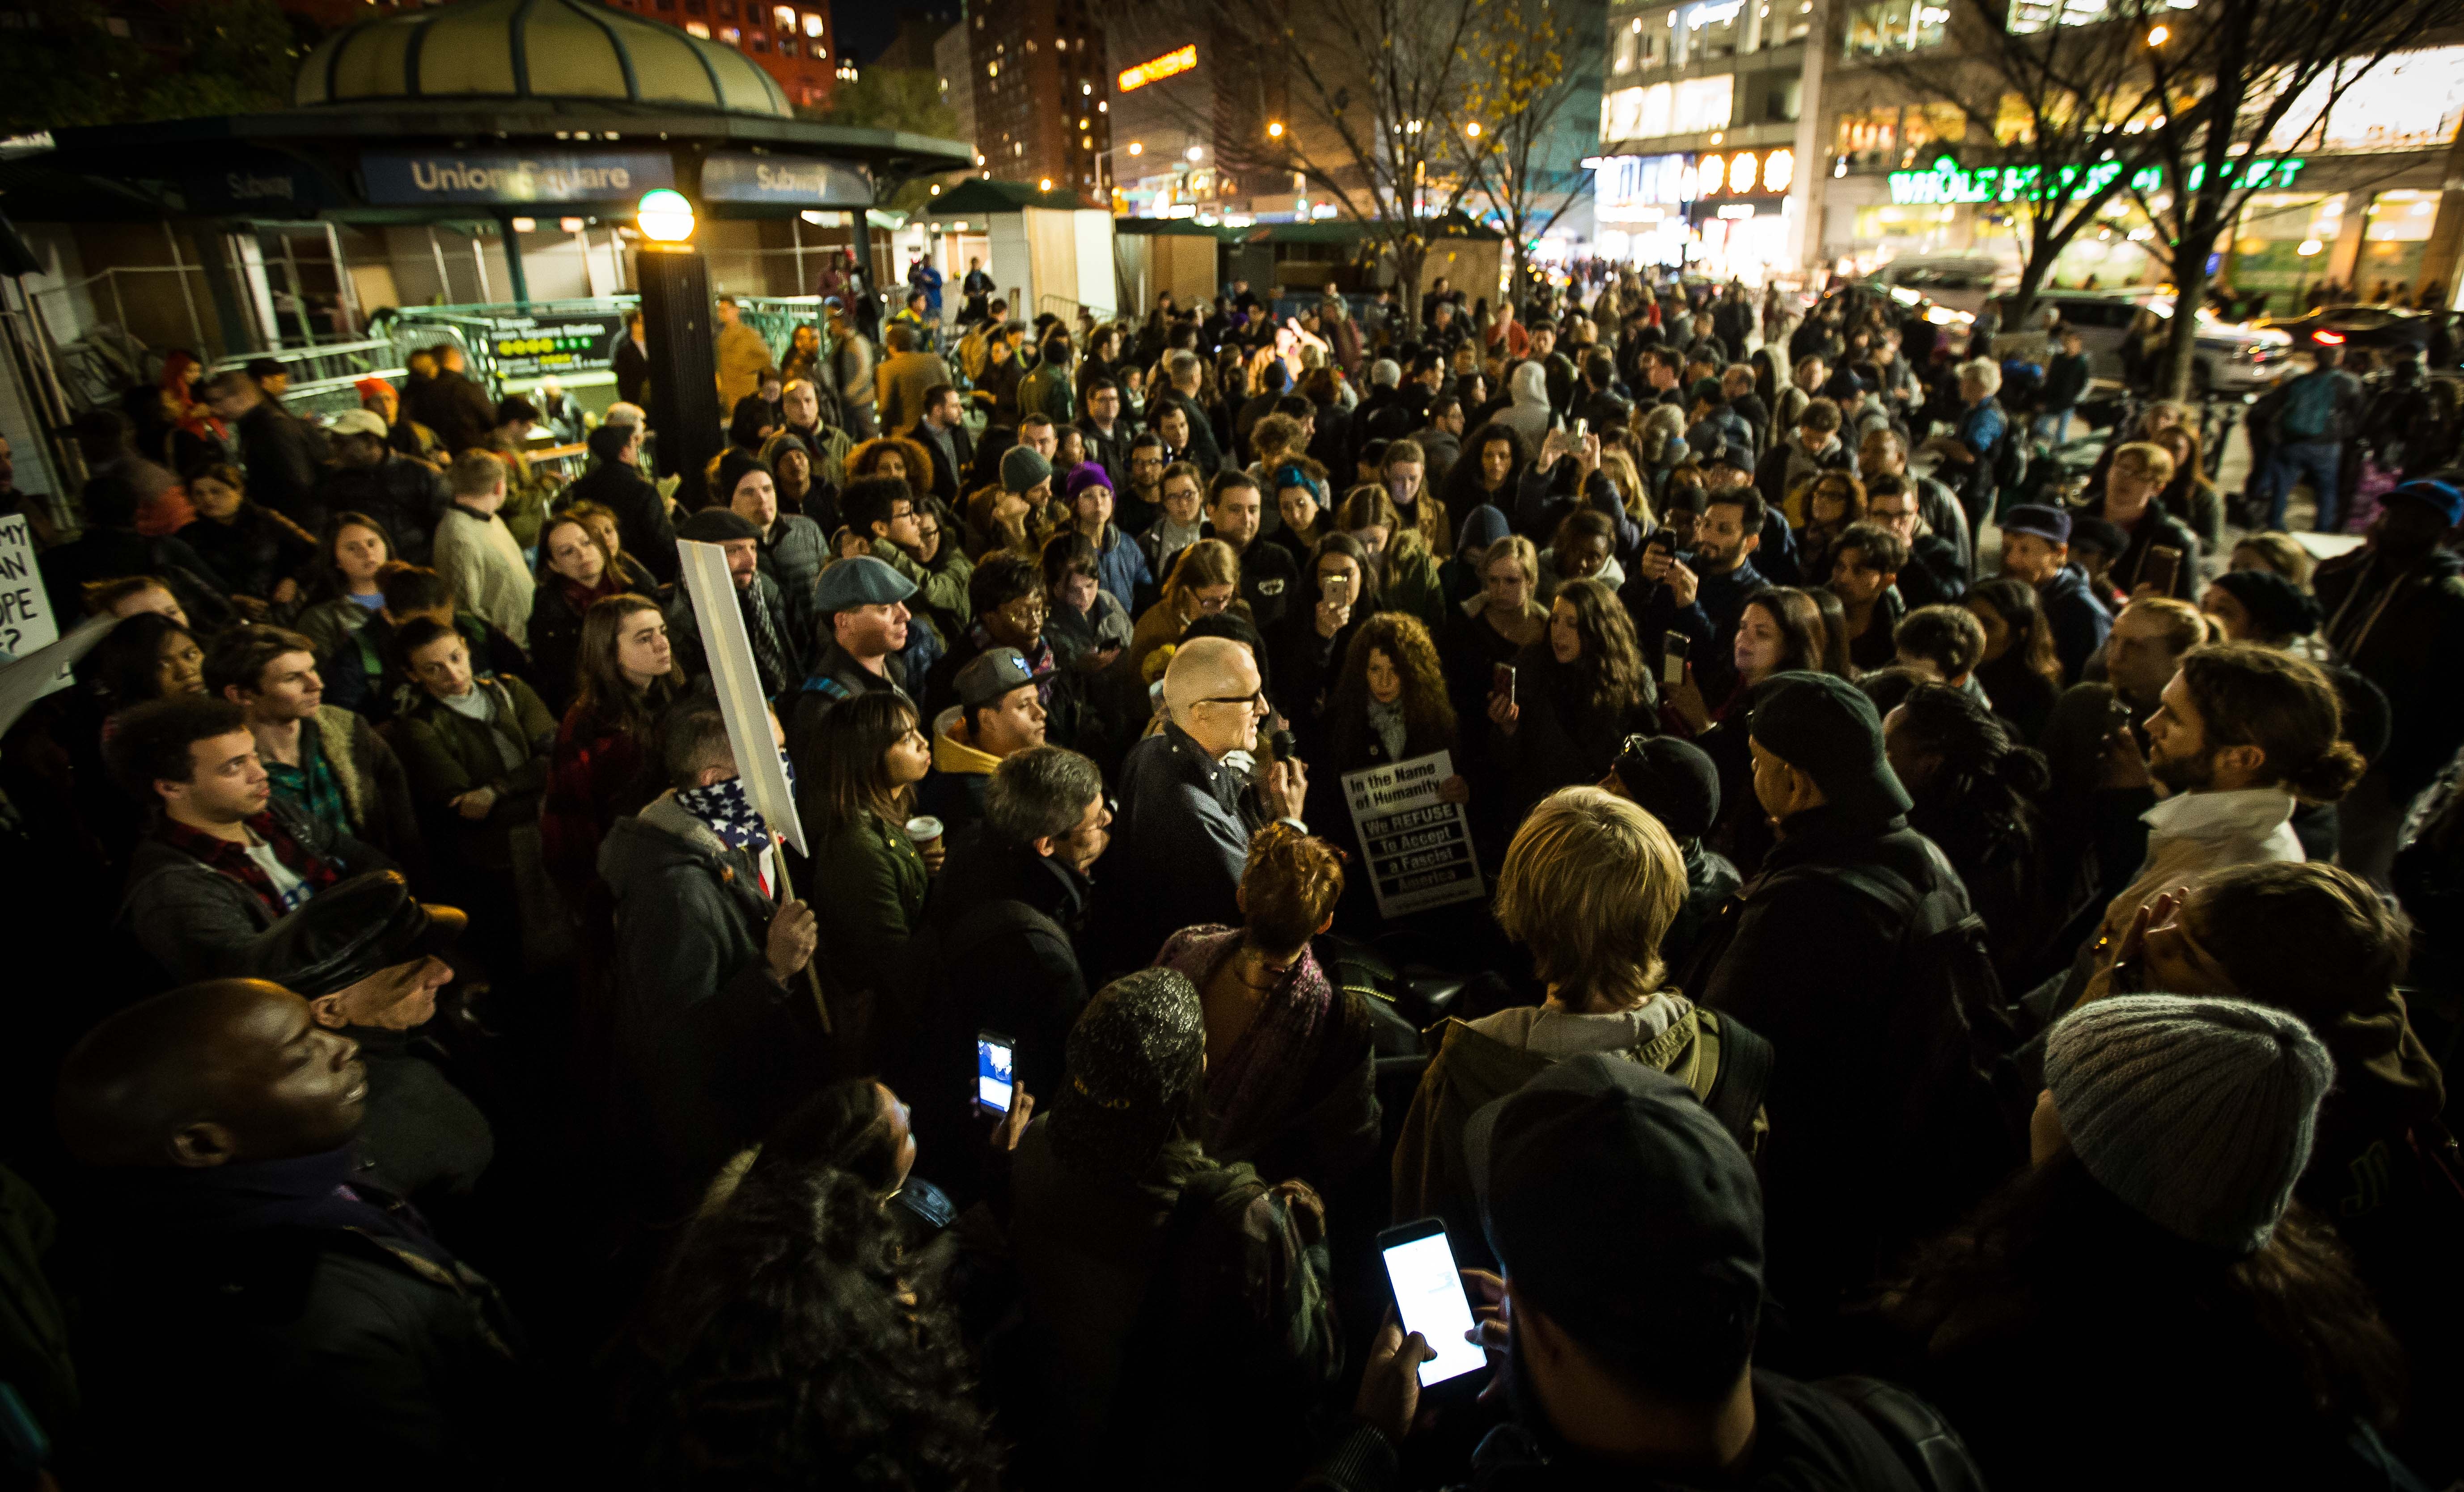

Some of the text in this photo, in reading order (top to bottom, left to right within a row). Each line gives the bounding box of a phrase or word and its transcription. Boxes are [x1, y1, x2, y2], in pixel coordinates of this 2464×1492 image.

[411, 160, 630, 198] Union Square
[756, 163, 827, 199] Subway
[1888, 154, 2000, 204] WHOLE
[0, 588, 38, 624] PE
[1350, 763, 1435, 793] In the Name
[1355, 780, 1441, 810] of Humanity
[1367, 805, 1454, 836] We REFUSE
[1401, 825, 1452, 850] Accept
[1389, 861, 1399, 874] a
